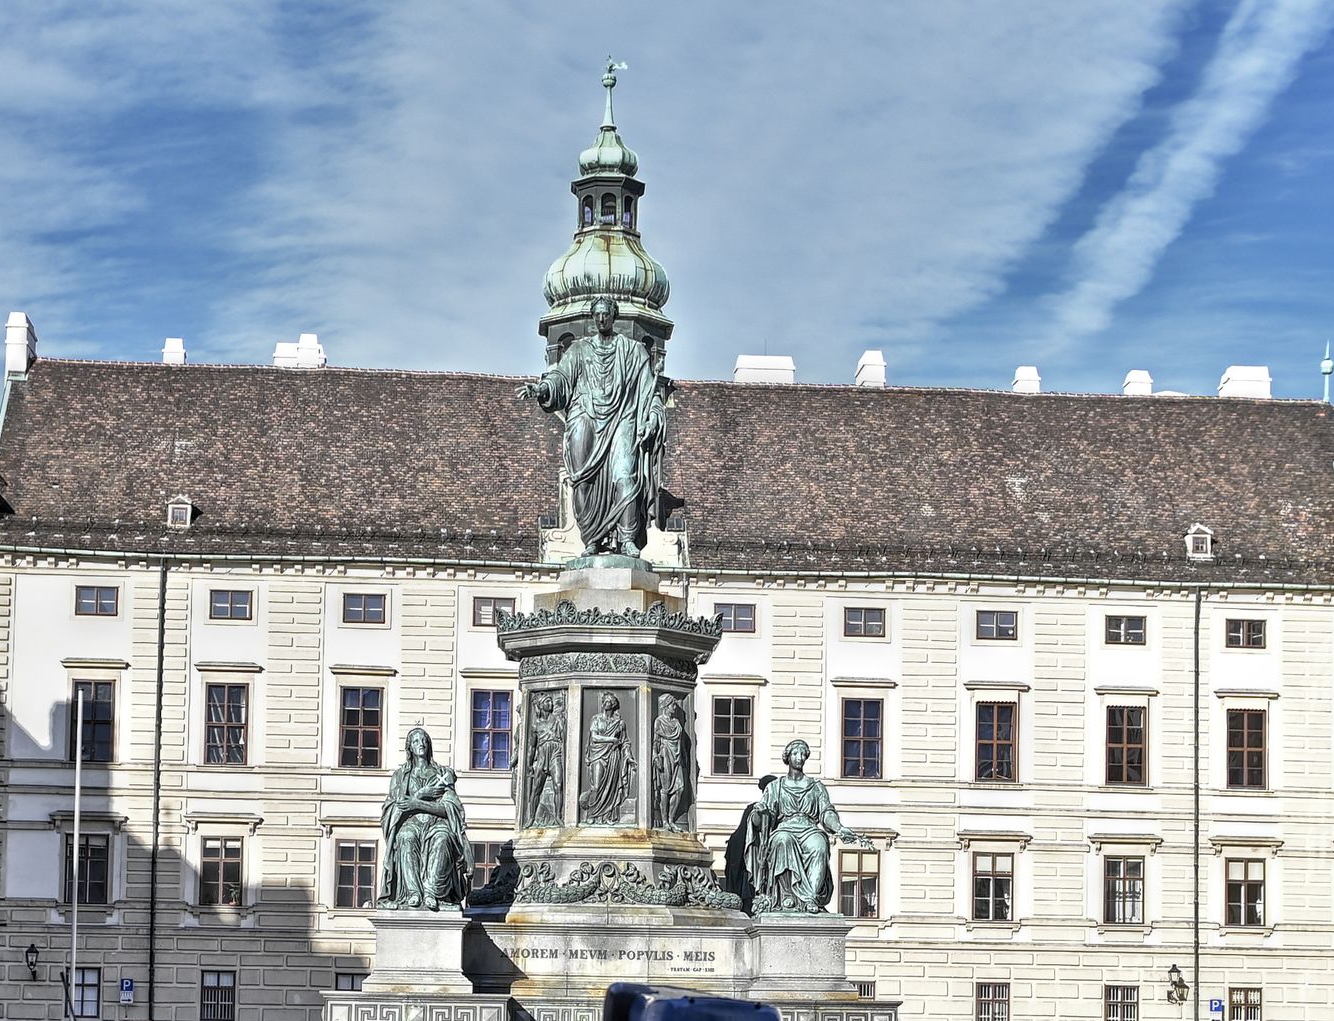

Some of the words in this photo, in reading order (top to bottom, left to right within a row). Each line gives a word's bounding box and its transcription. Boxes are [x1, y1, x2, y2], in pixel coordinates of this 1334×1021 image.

[500, 947, 559, 960] AMOREM
[568, 949, 608, 961] MEVM
[618, 950, 674, 961] POPVLIS
[683, 951, 715, 962] MEIS
[123, 980, 131, 991] P
[1212, 1000, 1220, 1011] P
